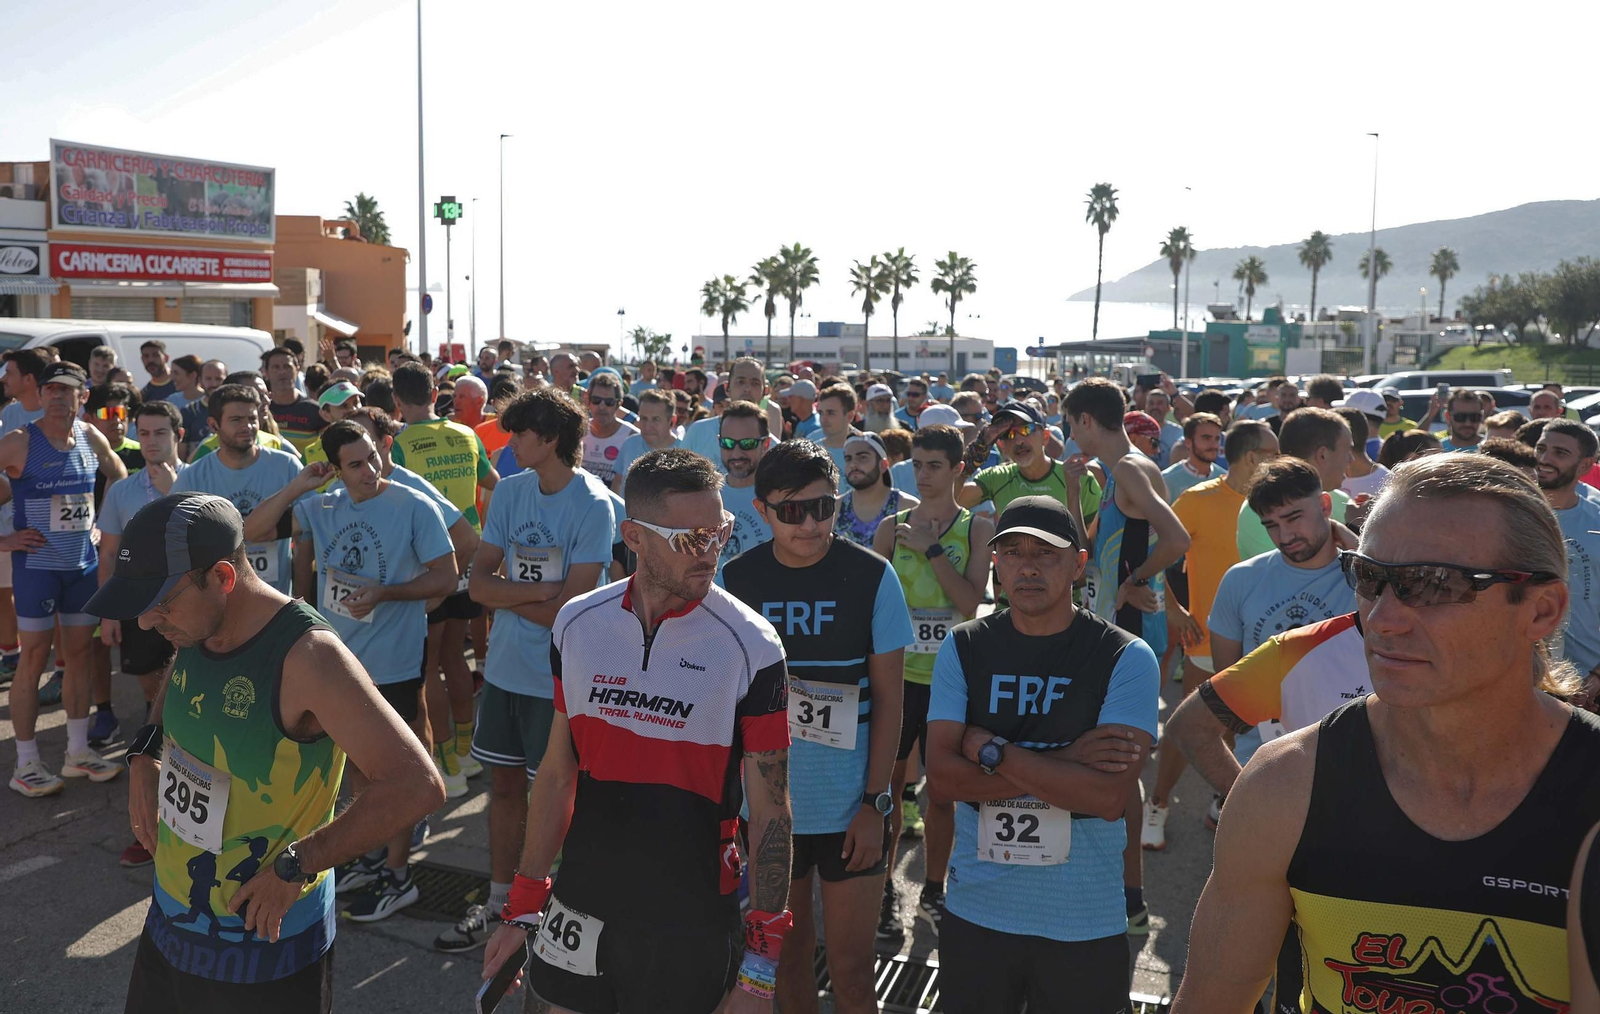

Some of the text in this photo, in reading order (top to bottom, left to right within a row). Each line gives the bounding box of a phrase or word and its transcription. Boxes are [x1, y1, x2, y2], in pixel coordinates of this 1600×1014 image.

[61, 184, 114, 204] Calidad
[63, 204, 126, 226] Crianza
[129, 213, 140, 230] y
[227, 217, 267, 236] Propia
[59, 250, 145, 273] CARNICERIA
[145, 254, 219, 277] CUCARRETE
[425, 452, 474, 468] RUNNERS
[60, 506, 90, 521] 244
[378, 552, 388, 586] ALGECIRA
[519, 562, 542, 582] 25
[762, 601, 836, 635] FRF
[919, 623, 947, 641] 86
[593, 674, 627, 686] CLUB
[588, 687, 694, 719] HARMAN
[814, 694, 844, 703] ALGECIRAS
[989, 674, 1072, 716] FRF
[599, 707, 686, 729] TRAIL RUNNING
[797, 700, 831, 729] 31
[187, 771, 212, 791] ALGECIRAS
[164, 770, 210, 825] 295
[1015, 801, 1051, 810] ALGECIRAS
[995, 812, 1040, 843] 32
[1482, 875, 1570, 900] GSPORT
[1354, 933, 1409, 968] EL
